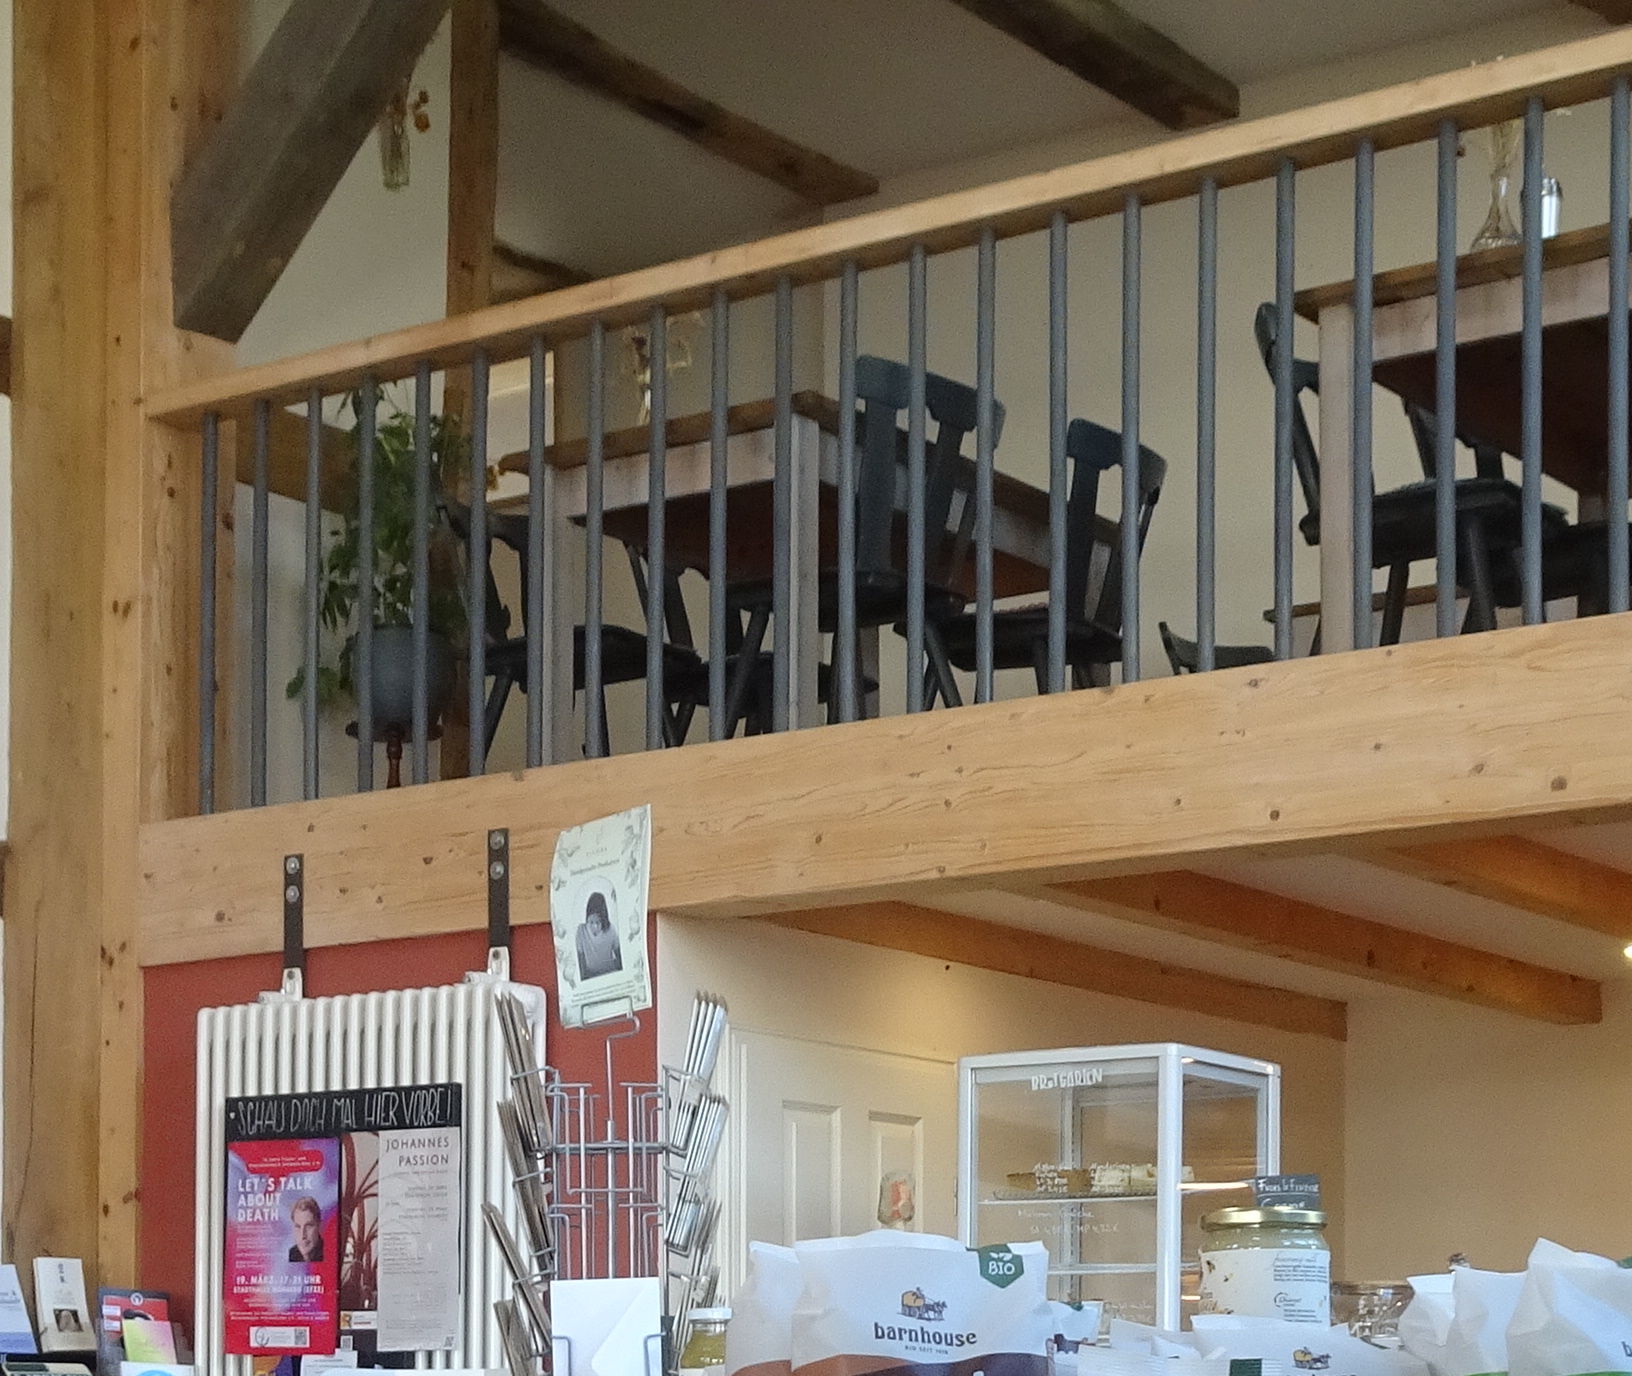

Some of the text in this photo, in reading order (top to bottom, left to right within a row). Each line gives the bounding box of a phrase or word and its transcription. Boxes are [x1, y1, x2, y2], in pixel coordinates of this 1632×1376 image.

[237, 1100, 286, 1136] SCHAU
[331, 1097, 358, 1131] MAL
[364, 1090, 399, 1127] HIER
[385, 1135, 450, 1153] JOHANNES
[398, 1153, 449, 1167] PASSION
[280, 1174, 314, 1192] TALK
[237, 1191, 282, 1208] ABOUT
[237, 1206, 280, 1223] DEATH
[988, 1257, 1016, 1277] BIO
[874, 1321, 978, 1348] barnhouse
